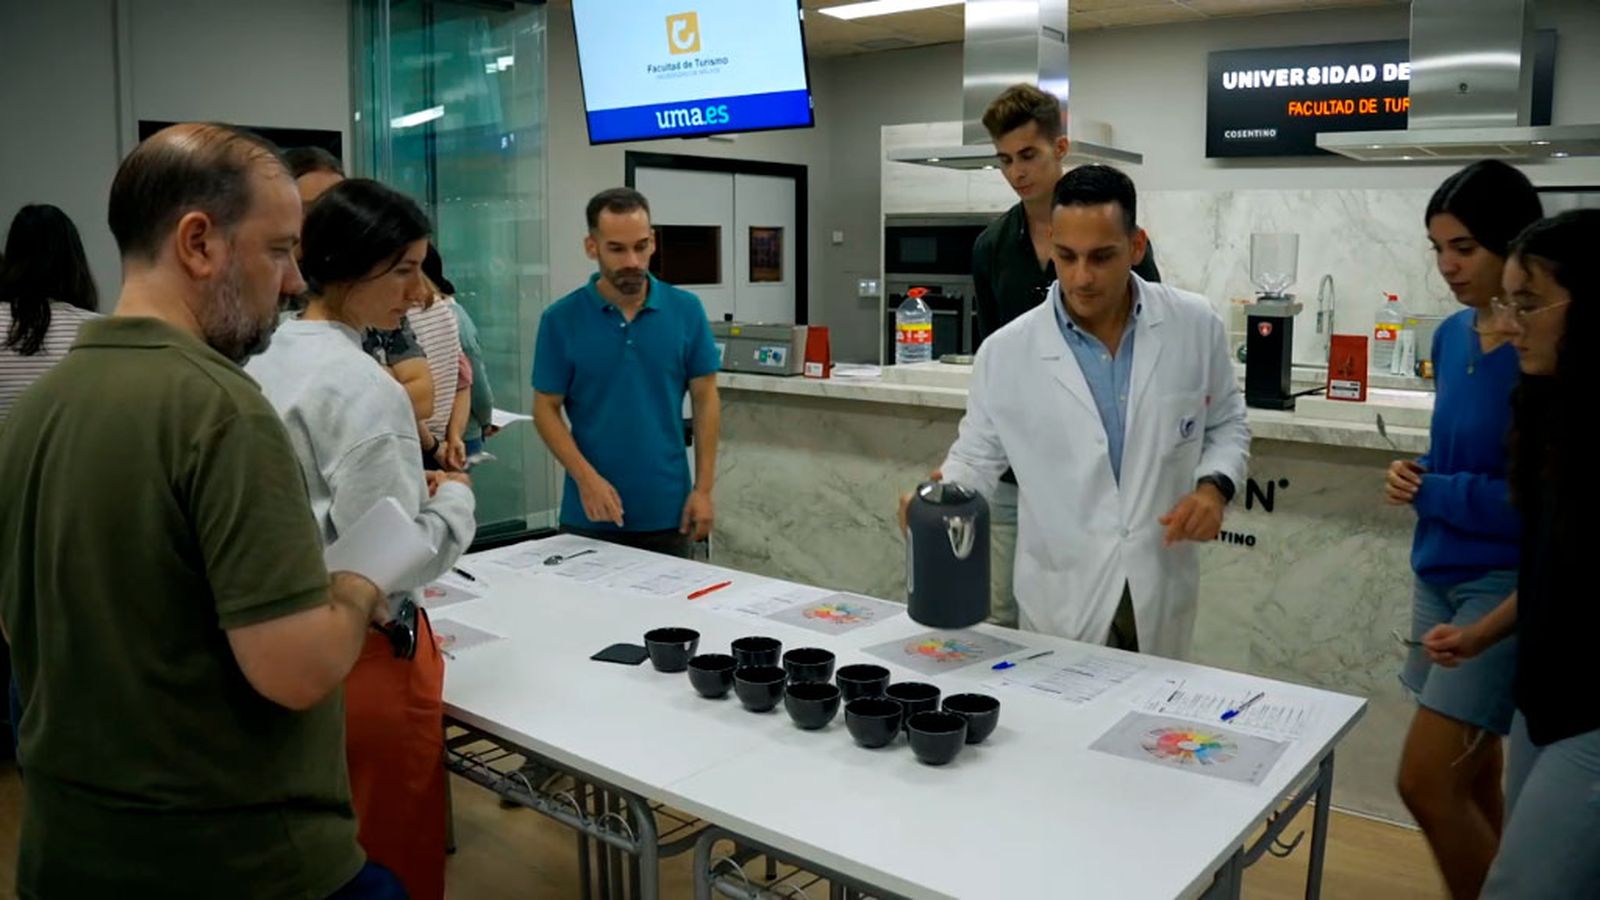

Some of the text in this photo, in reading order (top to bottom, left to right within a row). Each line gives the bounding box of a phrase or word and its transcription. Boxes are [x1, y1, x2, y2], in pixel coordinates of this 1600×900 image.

[647, 62, 681, 73] Facultad
[683, 60, 693, 69] de
[694, 57, 729, 68] Turismo
[1223, 62, 1410, 89] UNIVERSIDAD DE
[1288, 100, 1354, 117] FACULTAD
[1358, 98, 1378, 114] DE
[1224, 129, 1277, 139] COSENTINO
[1216, 531, 1256, 546] TINO
